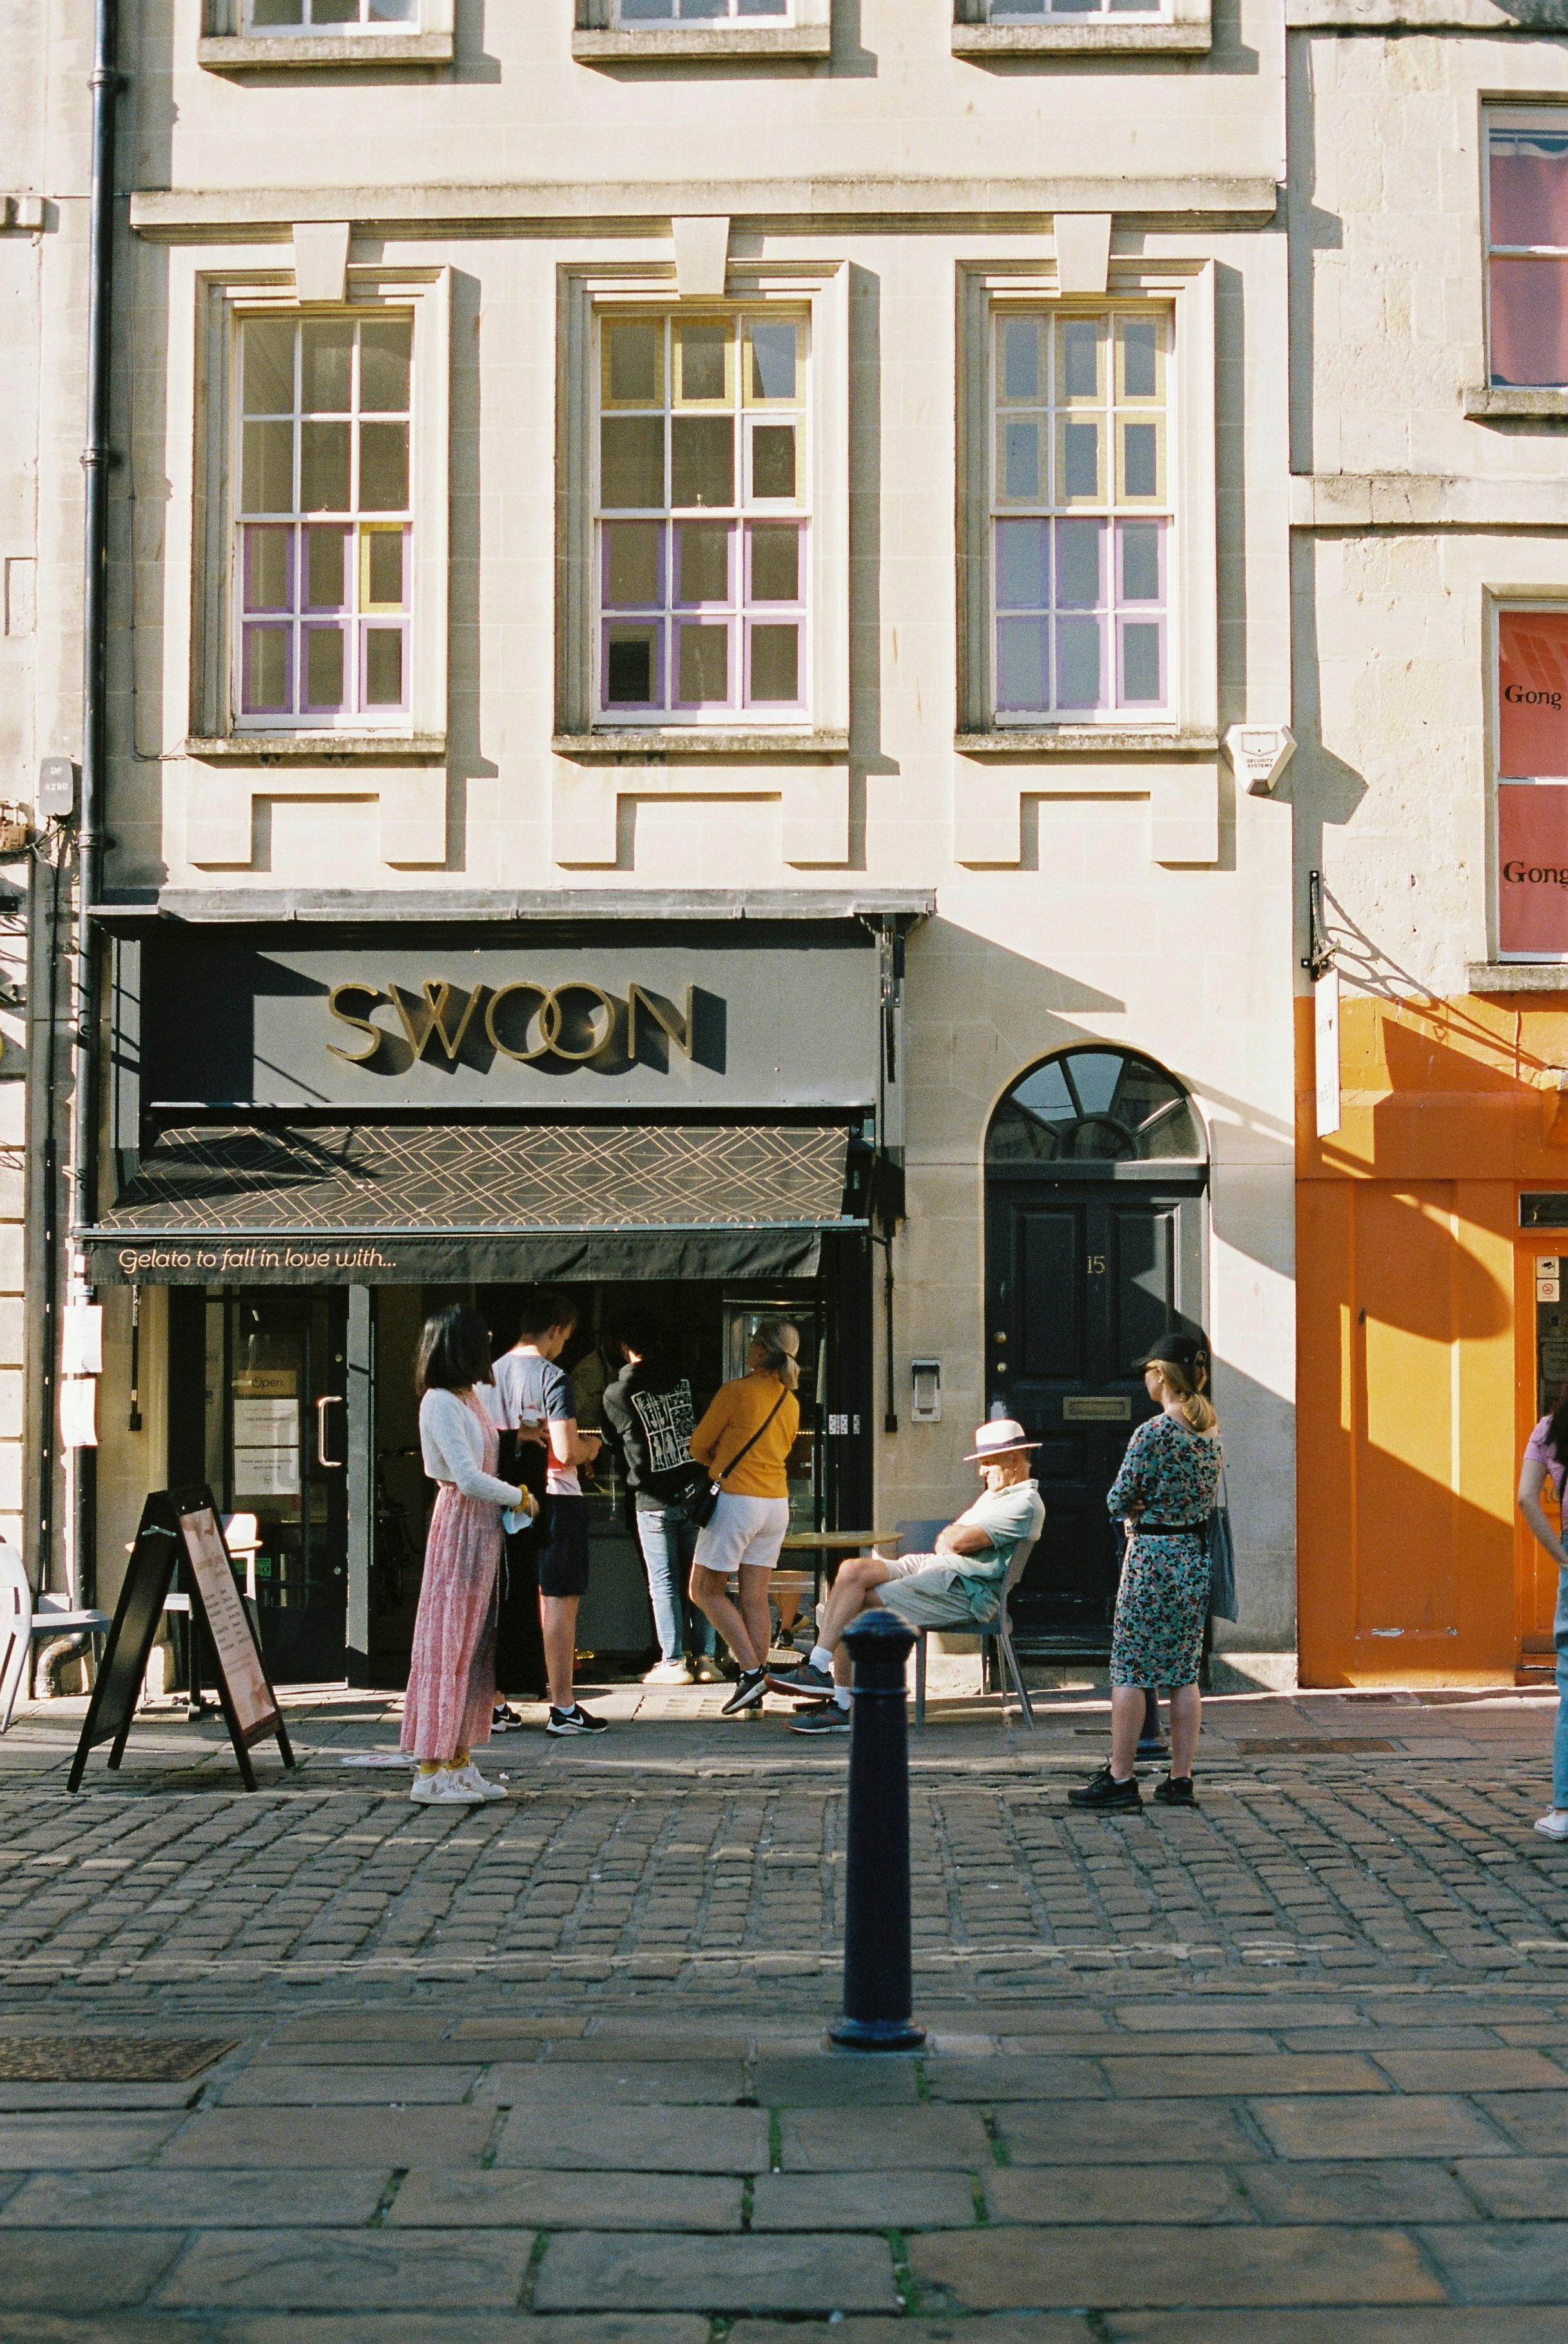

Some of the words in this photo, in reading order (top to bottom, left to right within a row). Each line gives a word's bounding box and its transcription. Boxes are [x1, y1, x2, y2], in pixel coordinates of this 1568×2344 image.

[1504, 684, 1562, 711] Gong
[1502, 860, 1568, 891] Gong
[325, 981, 694, 1060] SWOON
[119, 1248, 191, 1274] Gelato
[196, 1250, 217, 1268] to
[220, 1248, 255, 1272] fall
[260, 1248, 279, 1267] in
[285, 1248, 330, 1267] love
[335, 1248, 397, 1267] with...
[1087, 1255, 1106, 1274] 15
[251, 1376, 284, 1389] Open
